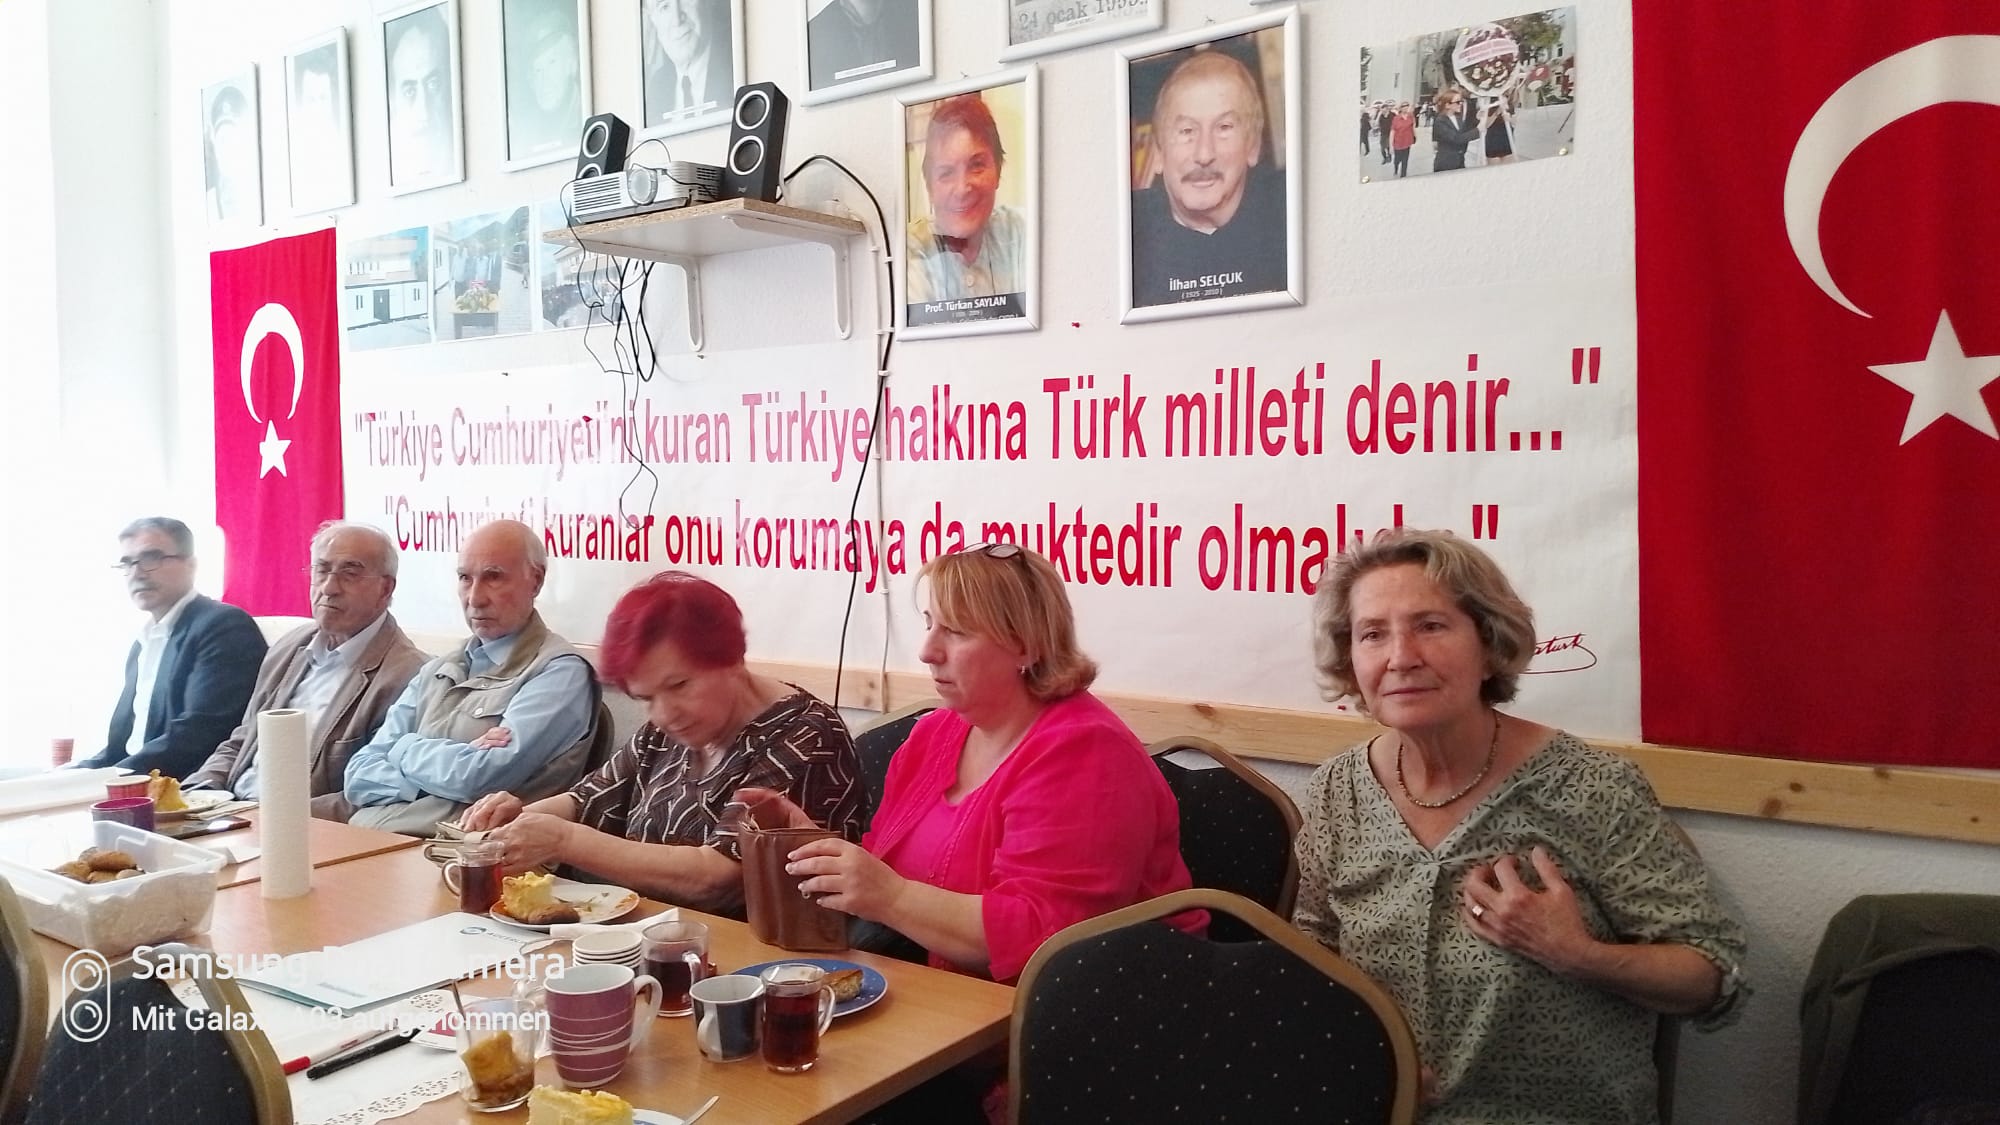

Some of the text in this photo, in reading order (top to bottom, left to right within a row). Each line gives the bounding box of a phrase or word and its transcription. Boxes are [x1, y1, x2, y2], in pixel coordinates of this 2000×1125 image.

[1018, 10, 1039, 31] 24
[1046, 2, 1088, 25] ocak
[1169, 271, 1243, 291] İlhan SELÇUK
[925, 296, 1007, 313] Prof. Türkan SAYLAN
[645, 398, 731, 464] kuran
[742, 389, 871, 482] Türkiye
[885, 383, 1027, 462] halkına
[1043, 373, 1147, 460] Türk
[1165, 362, 1326, 458] milleti
[544, 496, 655, 562] kuranlar
[665, 514, 723, 566] onu
[735, 498, 907, 594] korumaya
[920, 501, 965, 566] da
